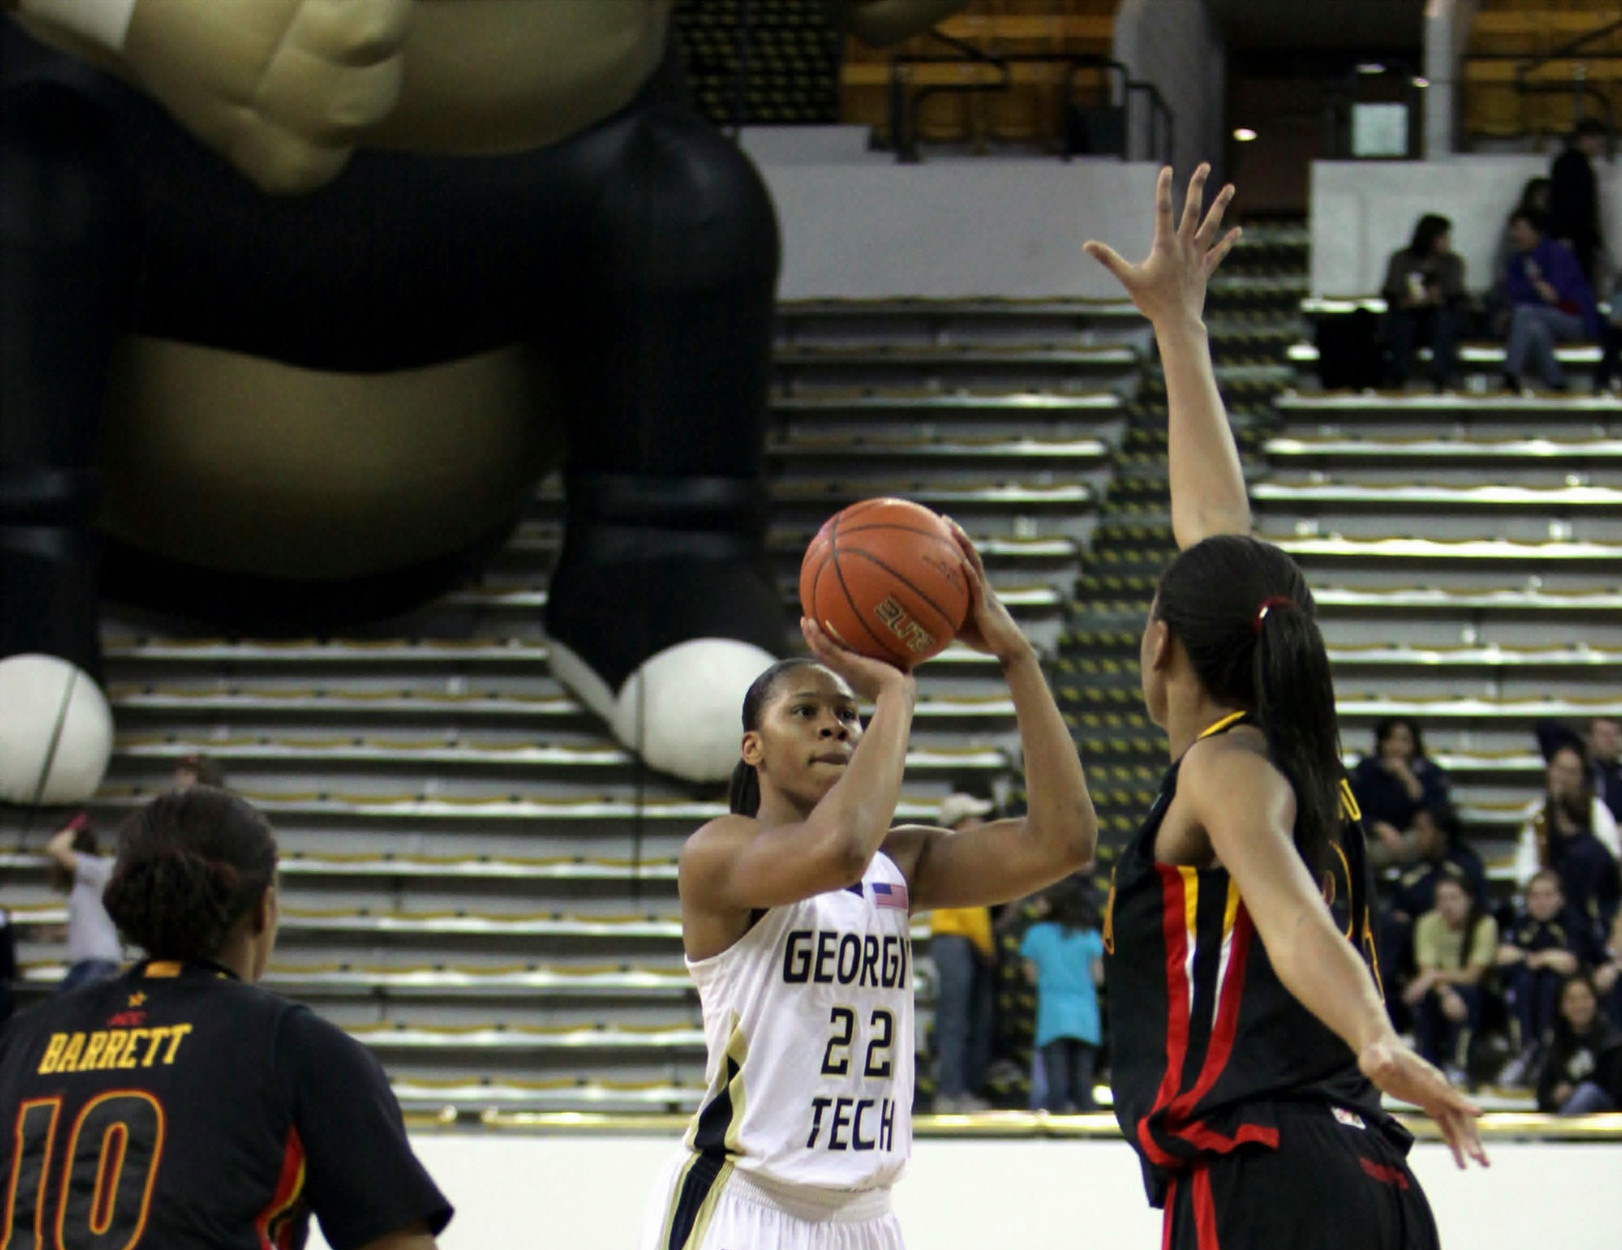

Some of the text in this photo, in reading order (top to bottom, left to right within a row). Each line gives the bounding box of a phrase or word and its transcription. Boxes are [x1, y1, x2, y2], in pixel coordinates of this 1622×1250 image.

[37, 1024, 192, 1075] BARRETT
[820, 1006, 896, 1079] 22
[806, 1097, 896, 1153] TECH
